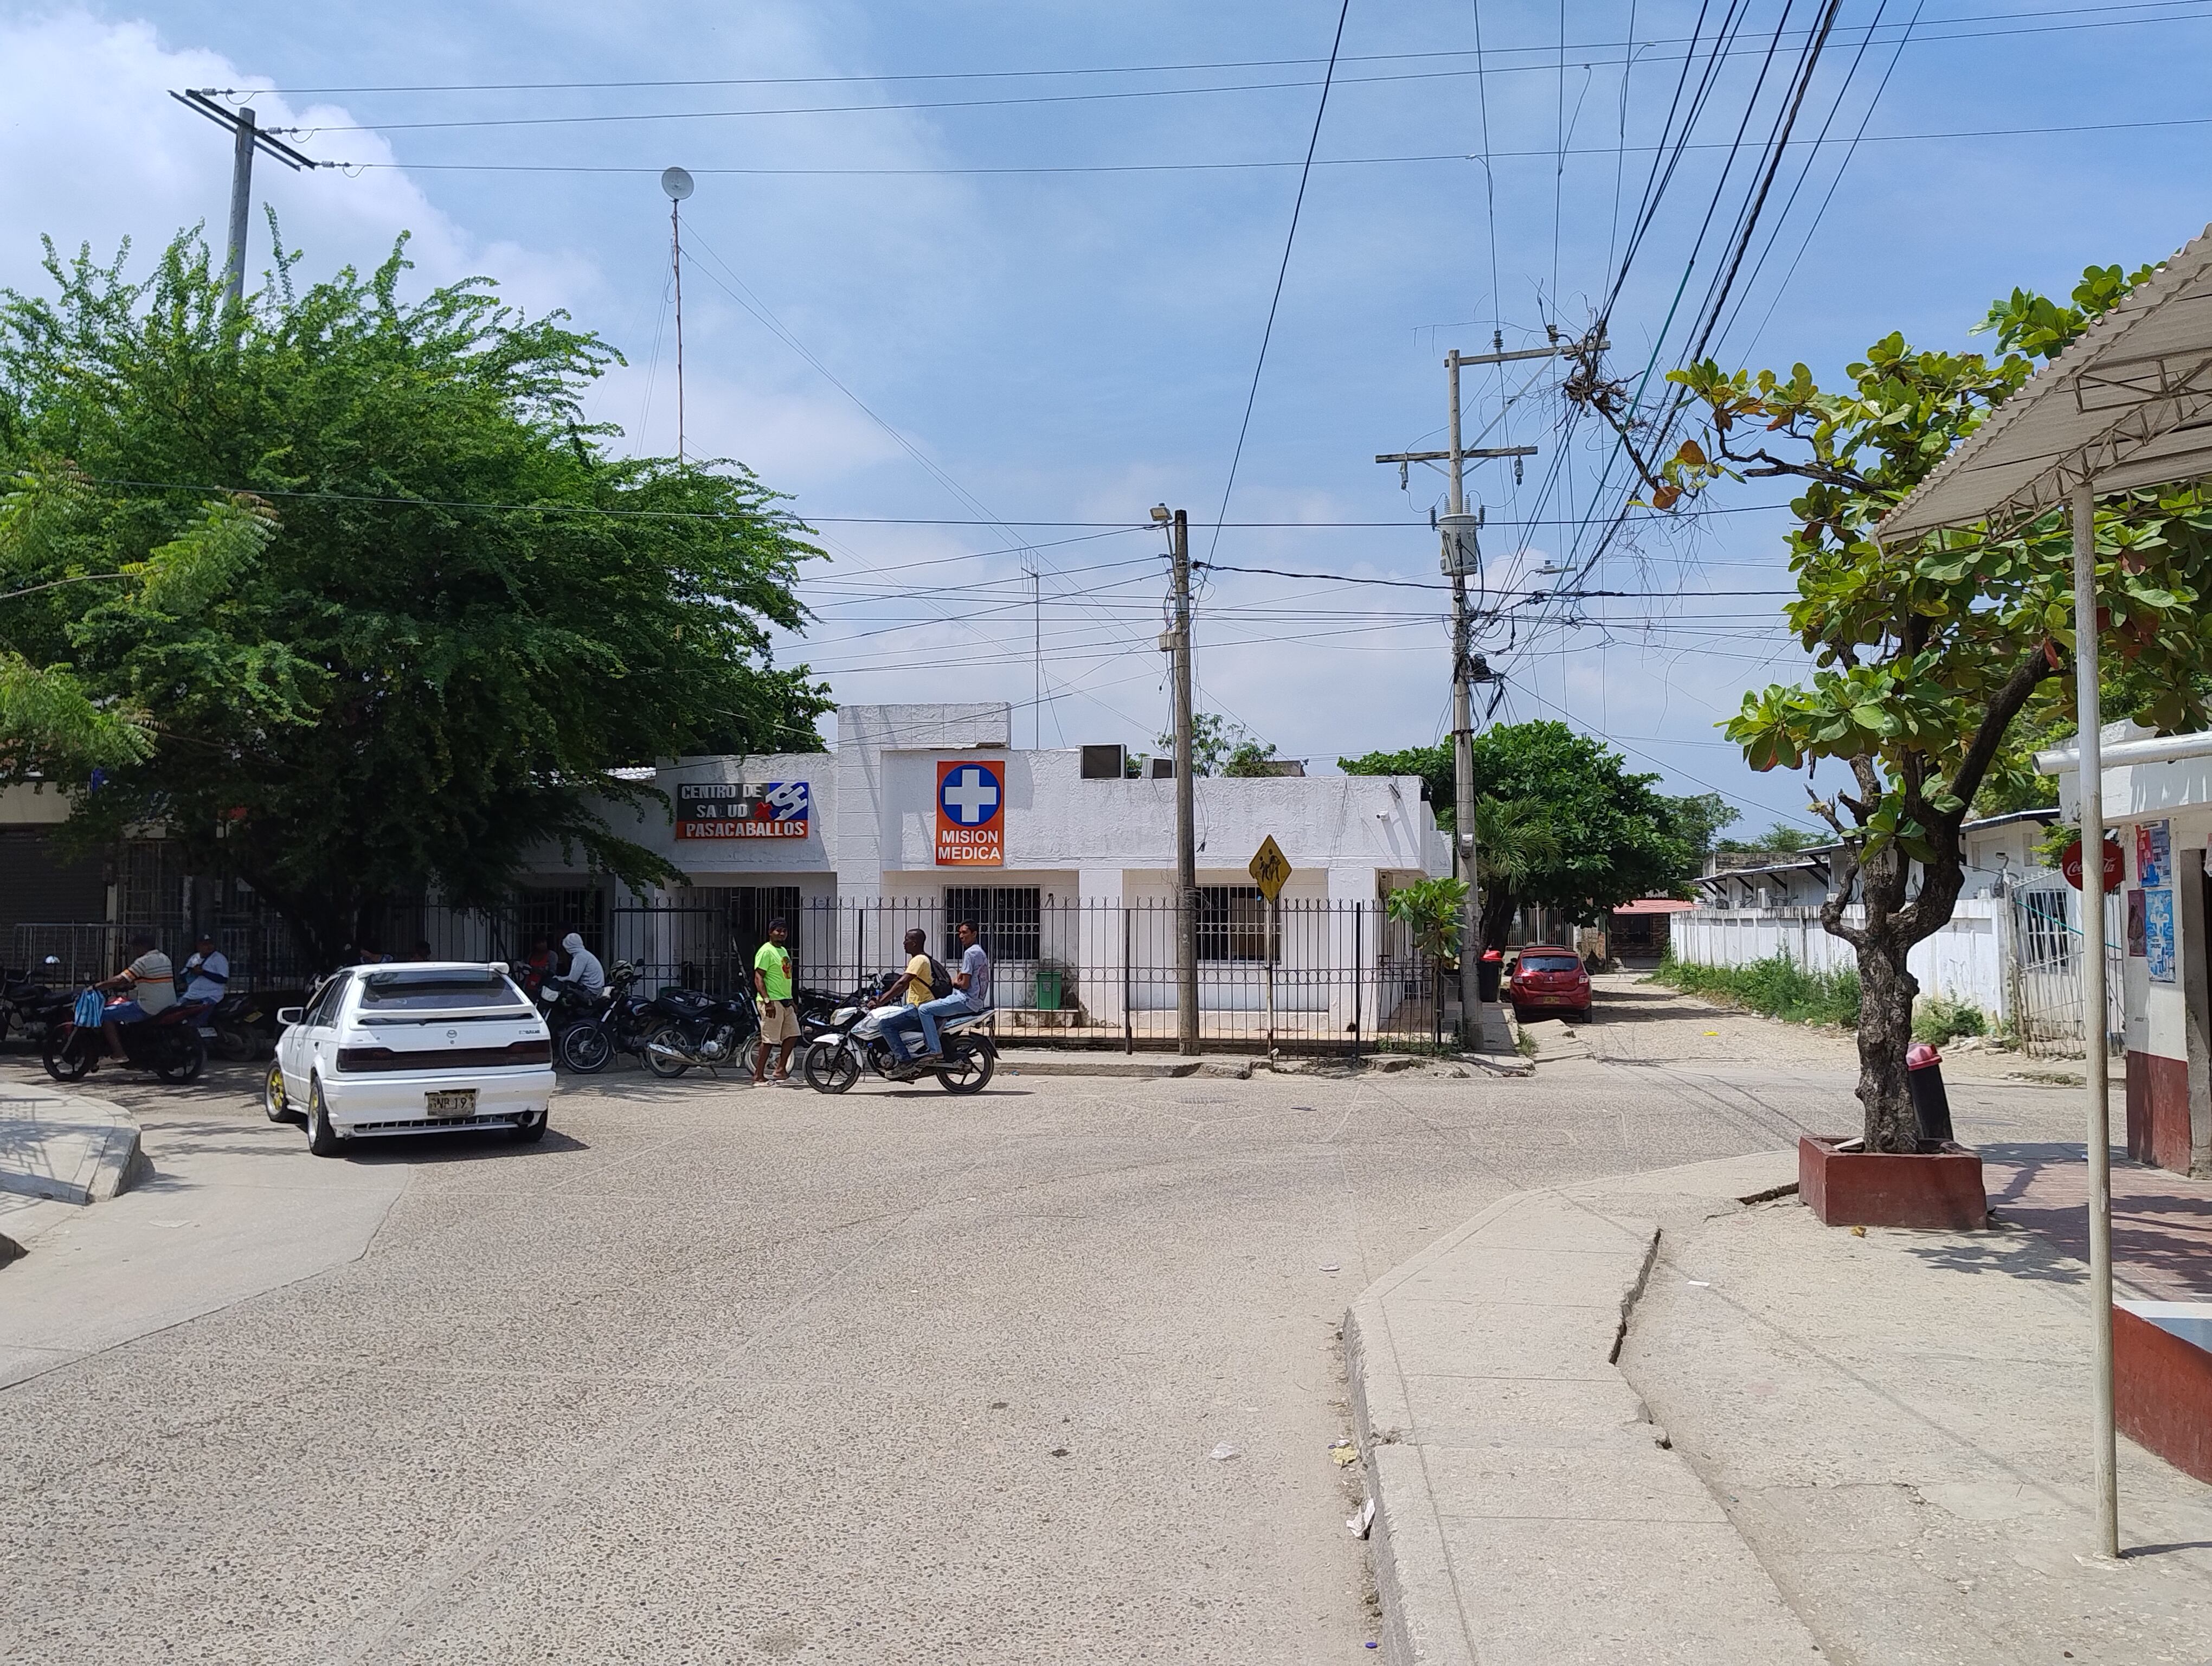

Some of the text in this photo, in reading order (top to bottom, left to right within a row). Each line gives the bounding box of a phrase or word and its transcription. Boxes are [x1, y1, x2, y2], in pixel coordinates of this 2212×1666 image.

[681, 784, 762, 799] CENTRO DE
[686, 822, 805, 837] PASACABALLOS
[942, 830, 998, 843] MISION
[938, 847, 1001, 860] MEDICA
